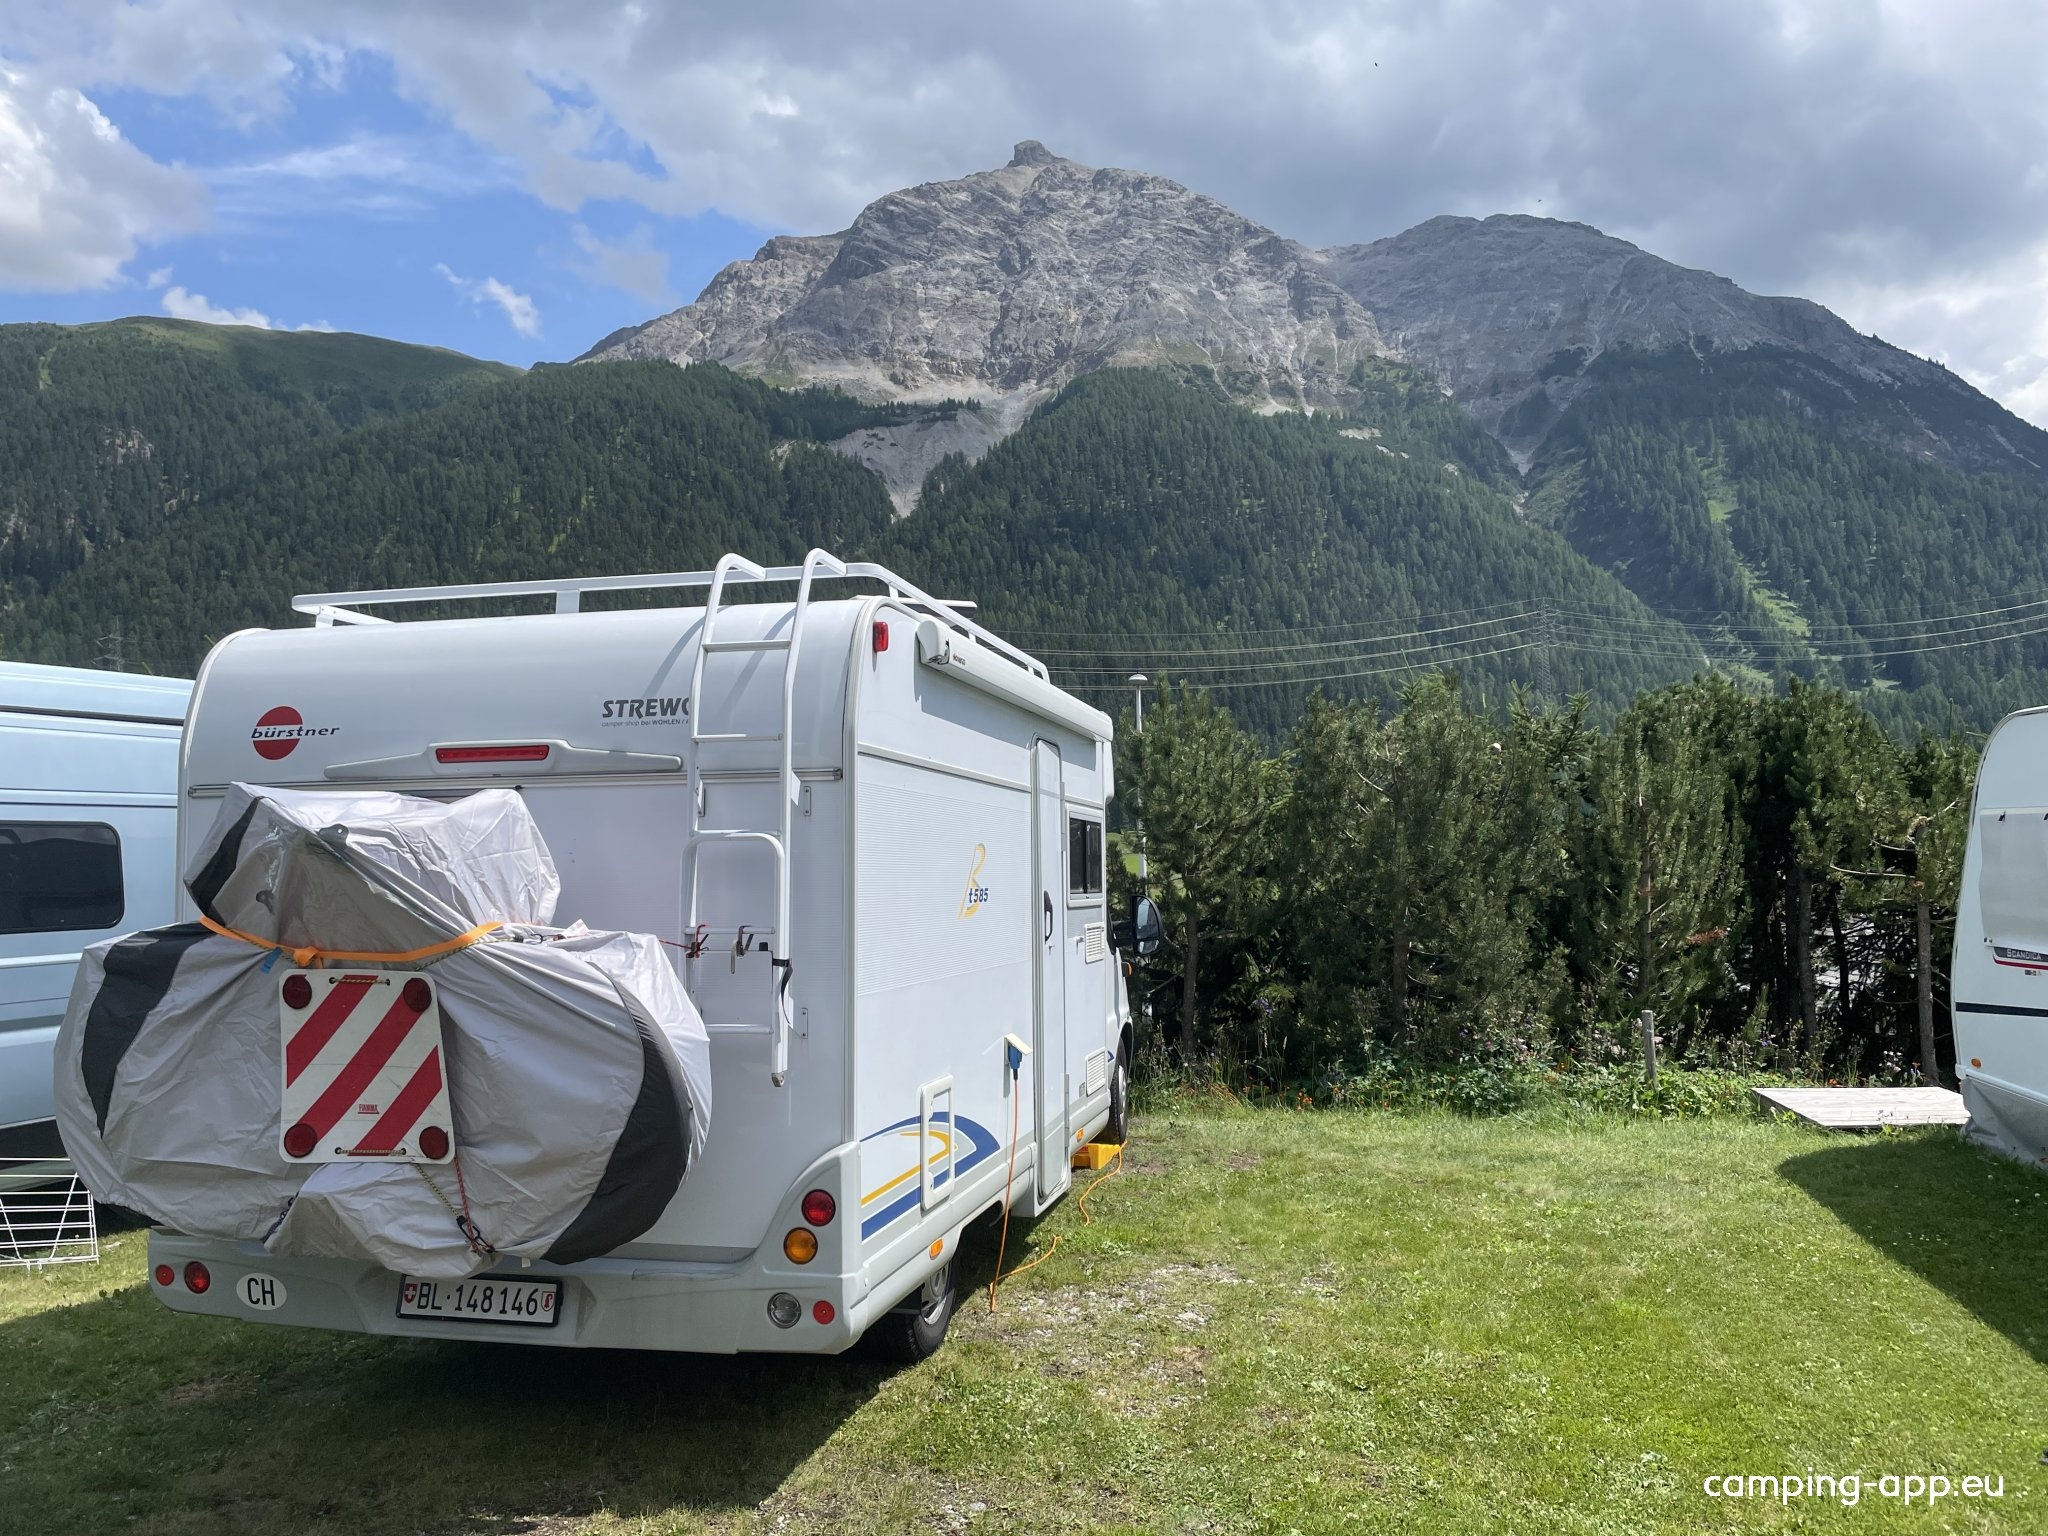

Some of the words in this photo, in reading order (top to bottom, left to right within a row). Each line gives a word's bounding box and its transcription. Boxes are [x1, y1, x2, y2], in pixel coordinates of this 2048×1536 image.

[251, 726, 340, 739] bürstner
[968, 887, 989, 904] t585
[247, 1278, 275, 1306] CH
